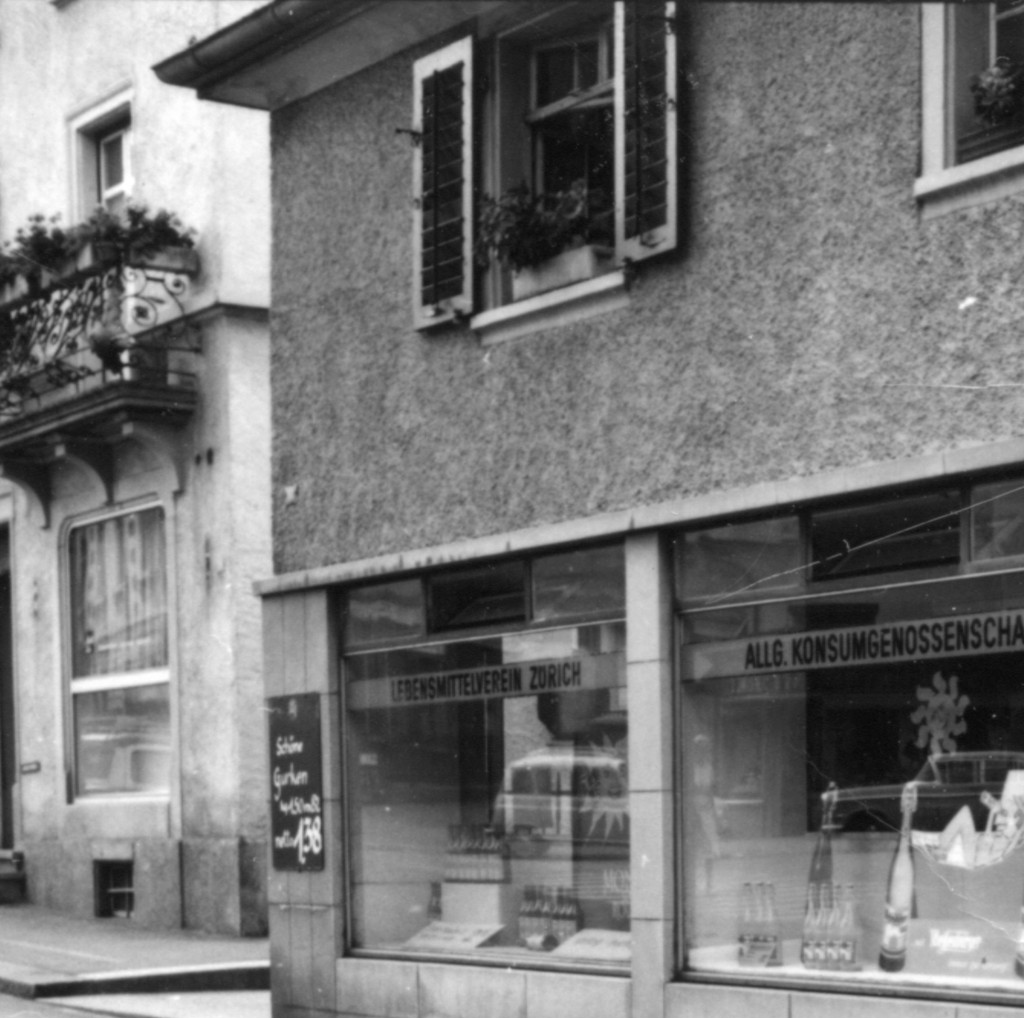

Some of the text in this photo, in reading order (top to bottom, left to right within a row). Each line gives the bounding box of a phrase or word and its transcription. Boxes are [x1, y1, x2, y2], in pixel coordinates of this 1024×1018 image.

[745, 642, 788, 670] ALLG.
[391, 661, 582, 702] LEBENSMITTELVEREIN ZÜRICH
[273, 762, 308, 801] Gurken
